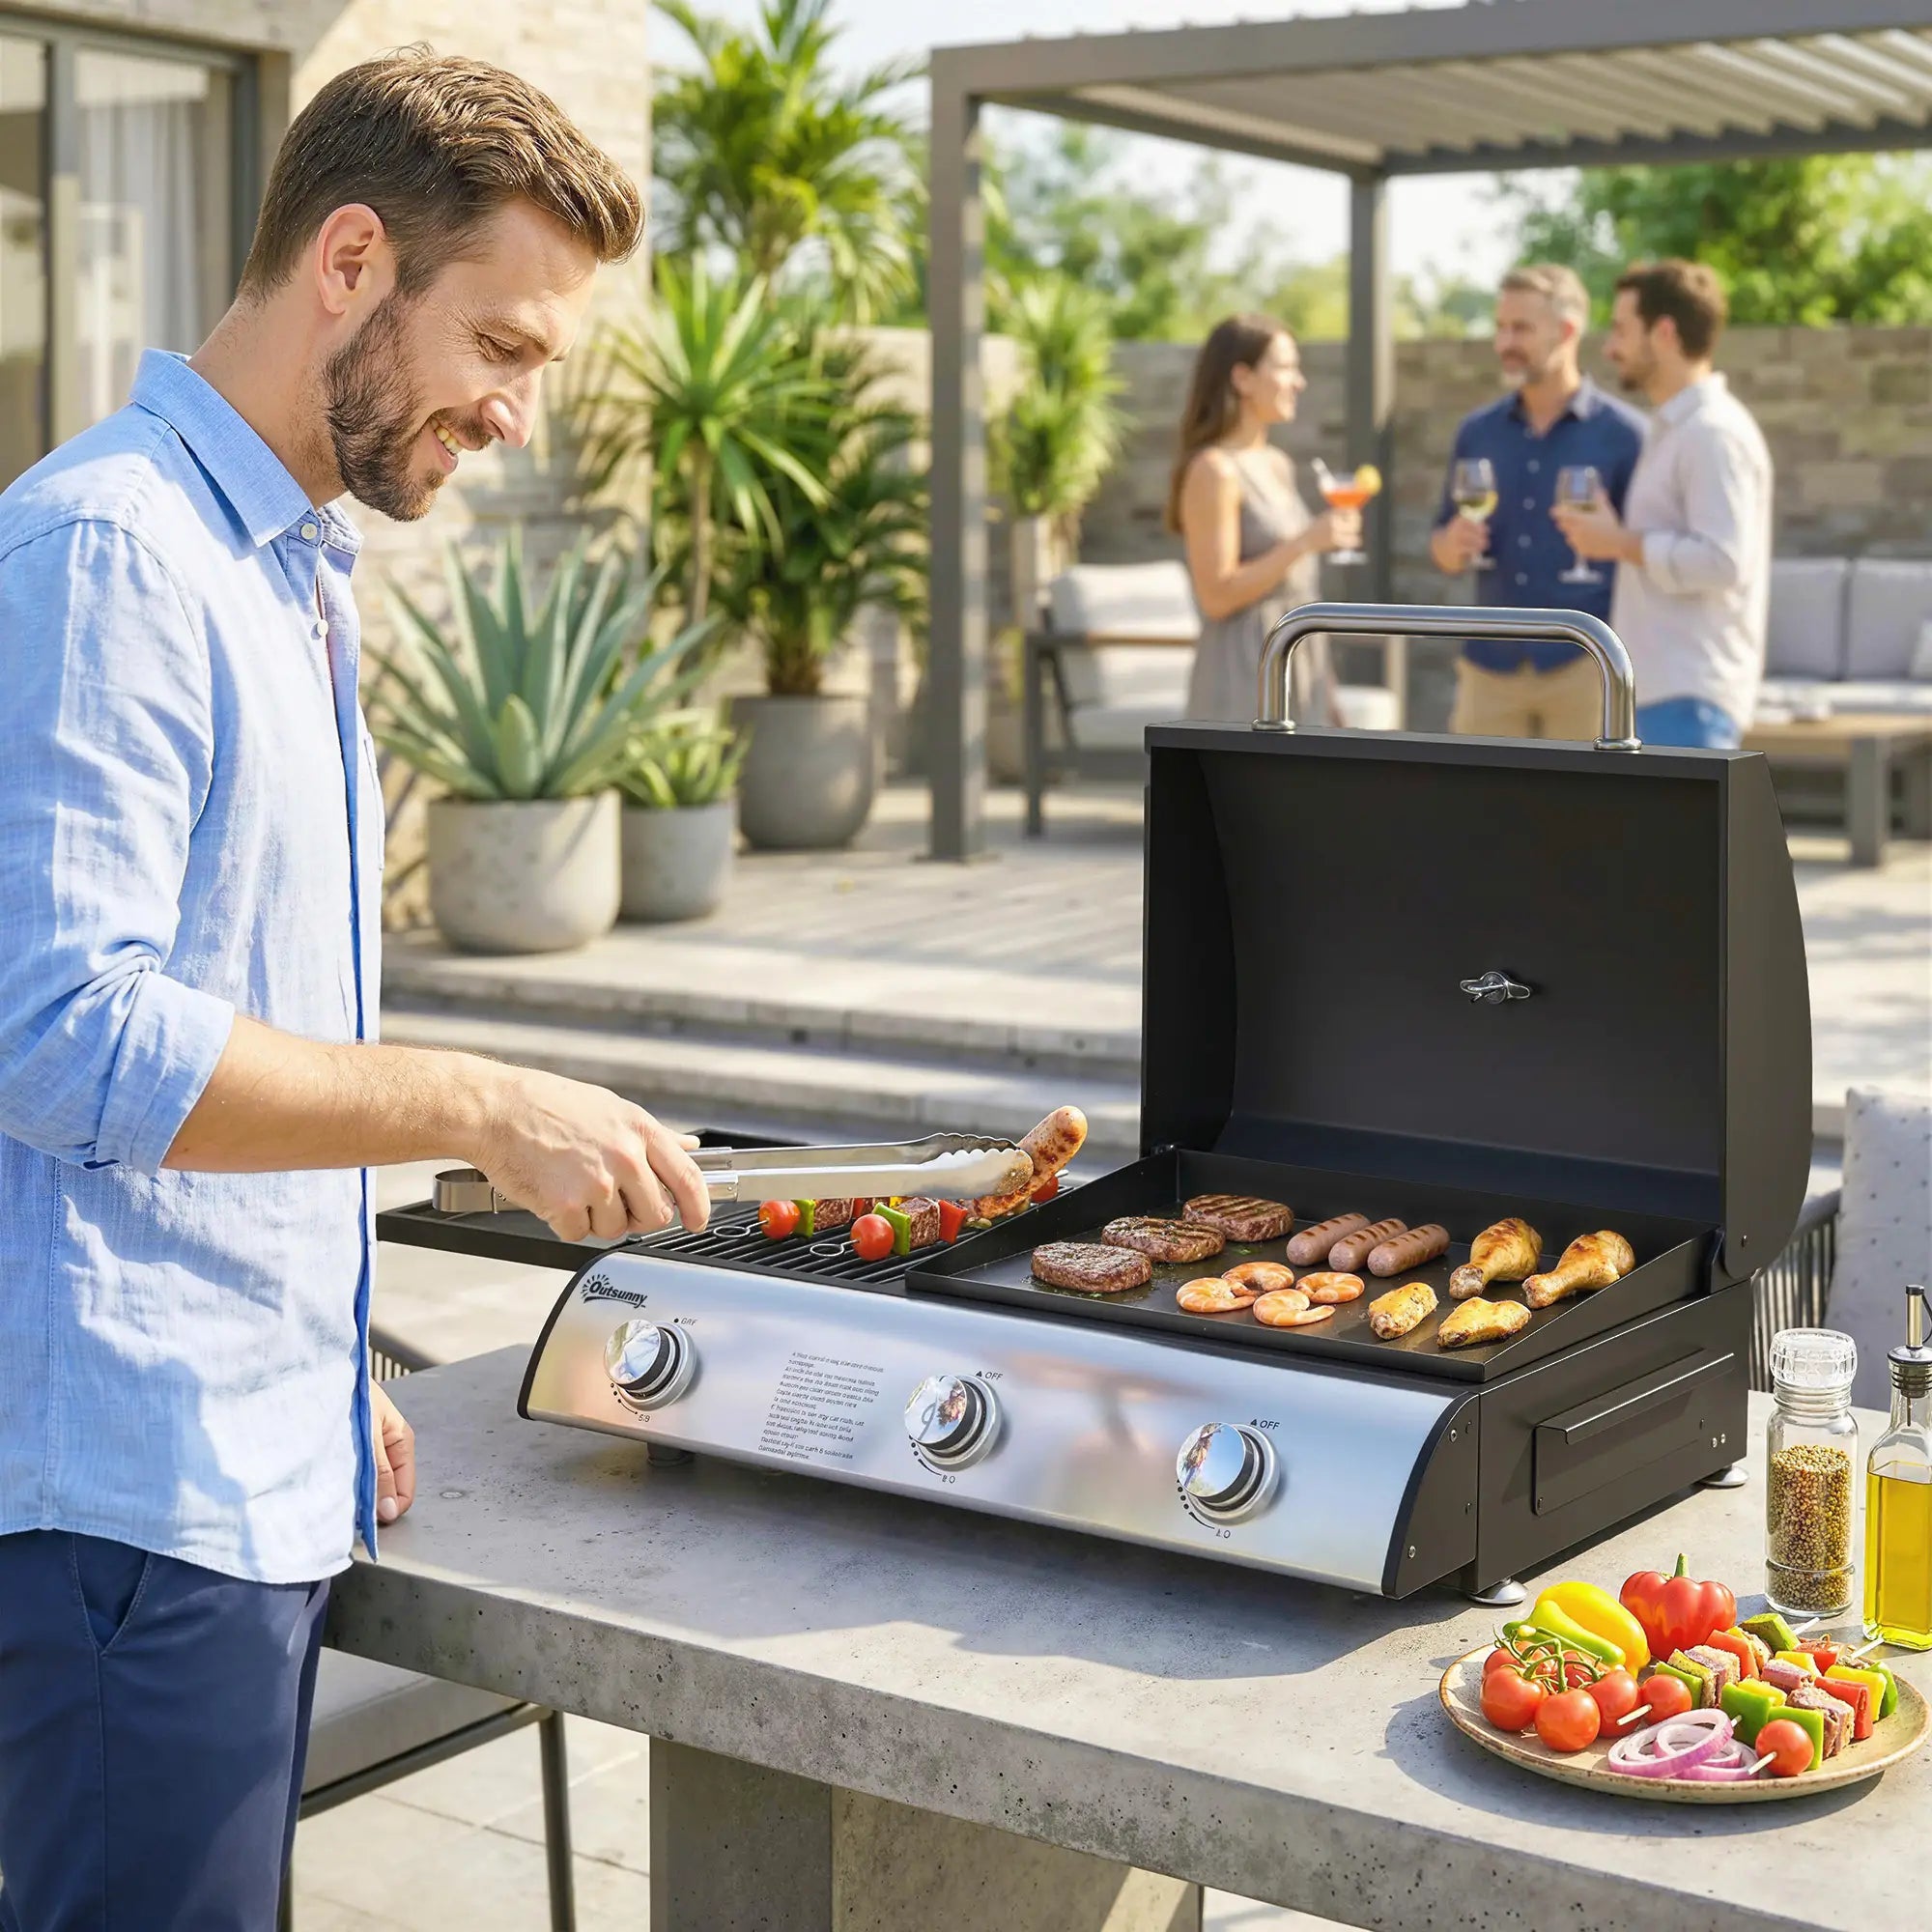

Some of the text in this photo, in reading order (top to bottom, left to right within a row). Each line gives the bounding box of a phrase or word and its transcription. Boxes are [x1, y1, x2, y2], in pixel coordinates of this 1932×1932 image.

[588, 1281, 648, 1309] Outsunny
[984, 1372, 1004, 1380] OFF
[1260, 1419, 1280, 1430] OFF
